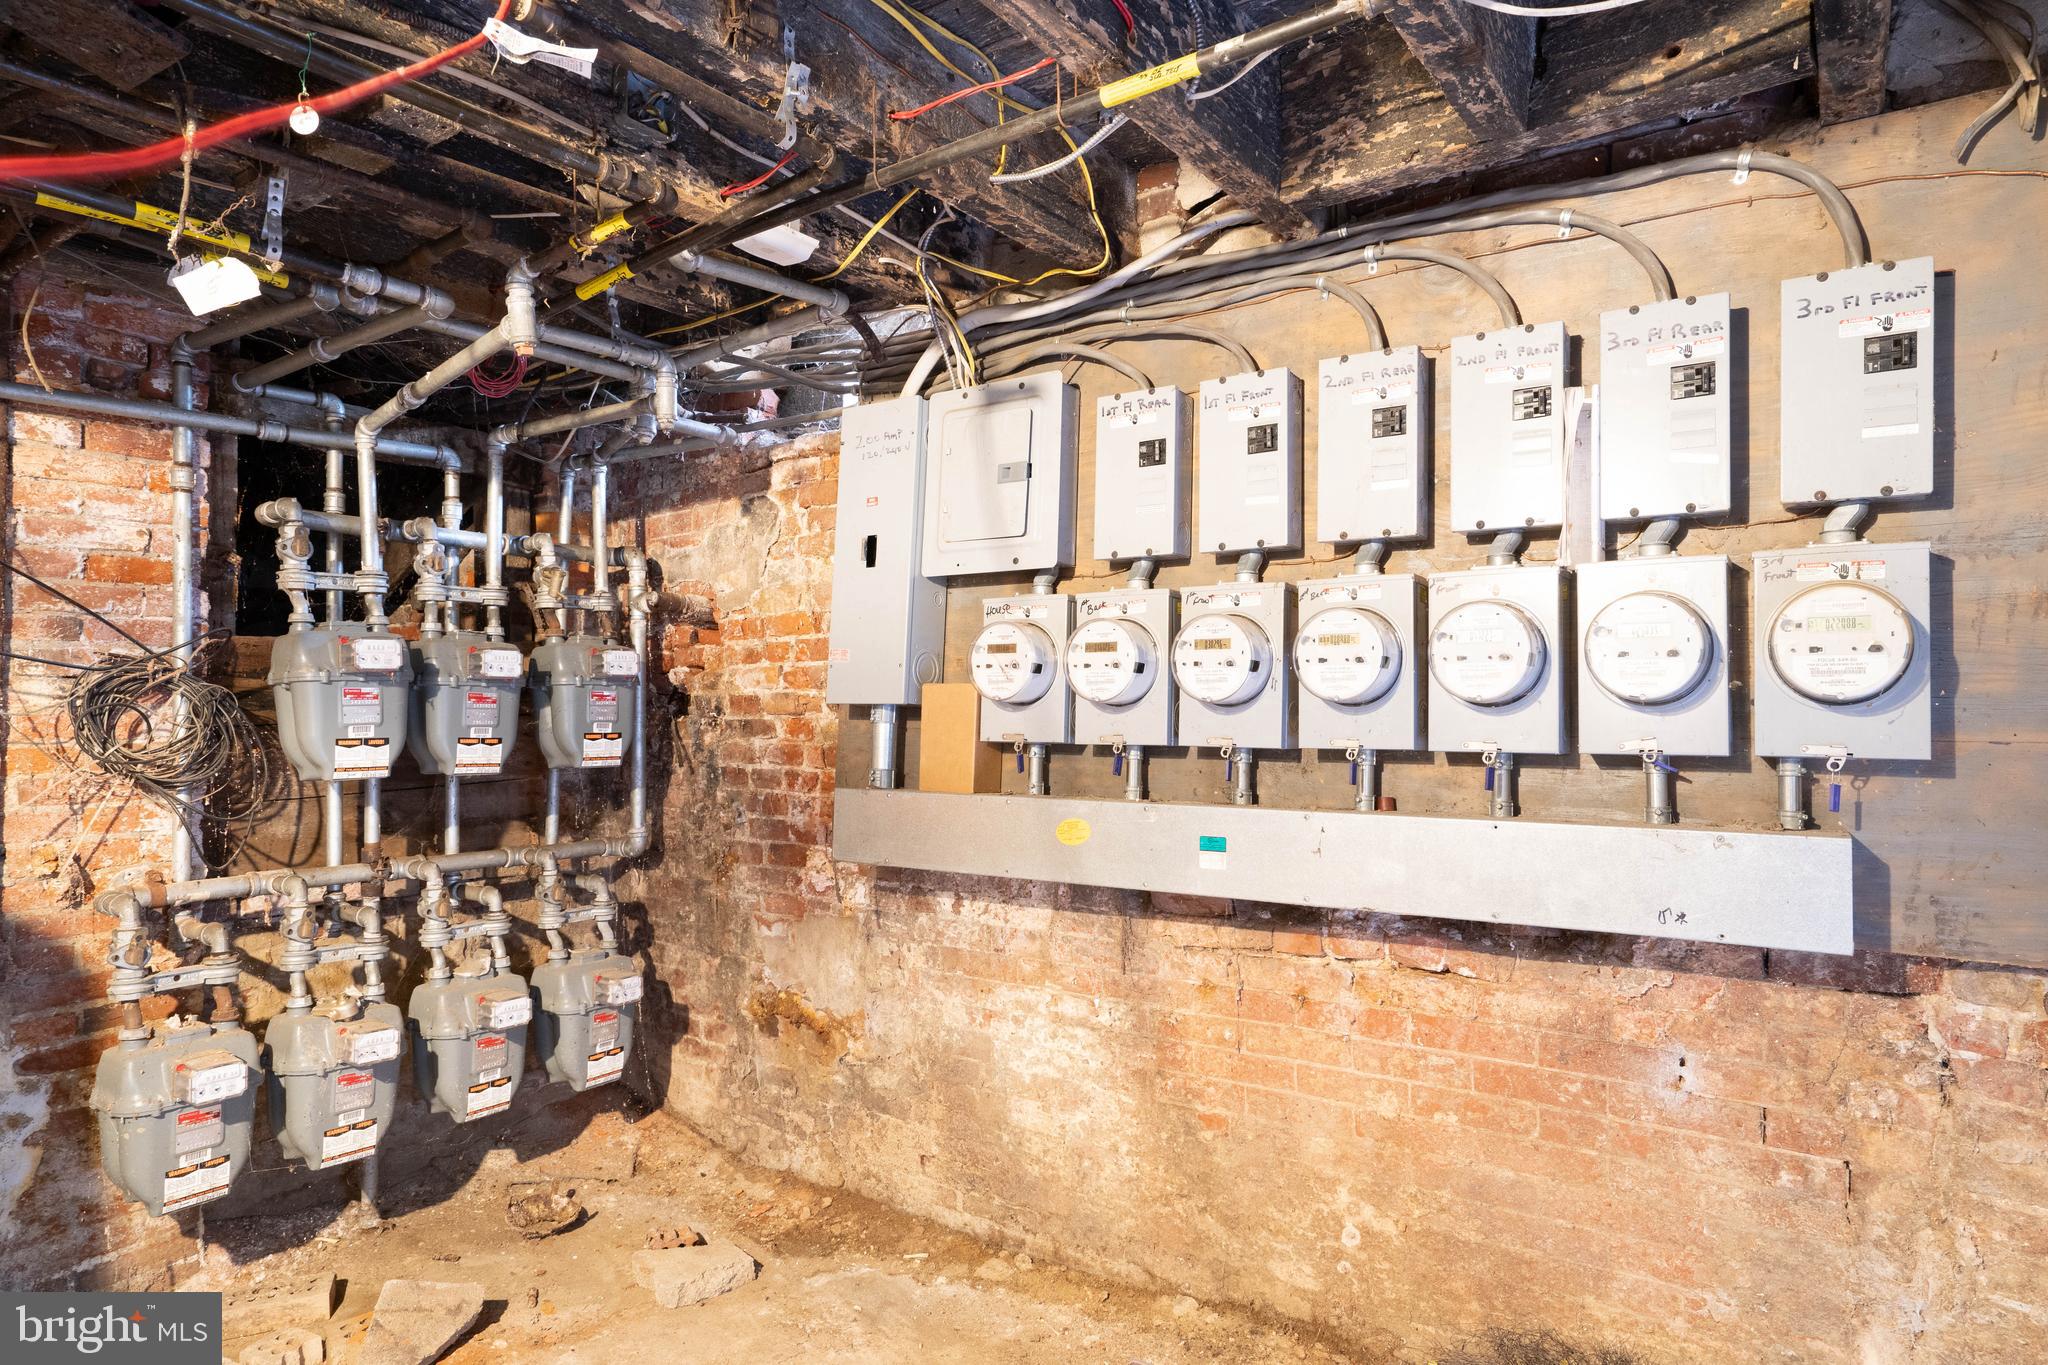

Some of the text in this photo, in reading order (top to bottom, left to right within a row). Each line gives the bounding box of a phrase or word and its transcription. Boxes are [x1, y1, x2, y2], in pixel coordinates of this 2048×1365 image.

[1870, 285, 1928, 306] FRONT
[1671, 321, 1724, 339] REAR
[1516, 343, 1560, 357] FRONT
[1381, 364, 1416, 379] REAR
[1241, 387, 1274, 402] FRONT
[1764, 568, 1797, 583] Front
